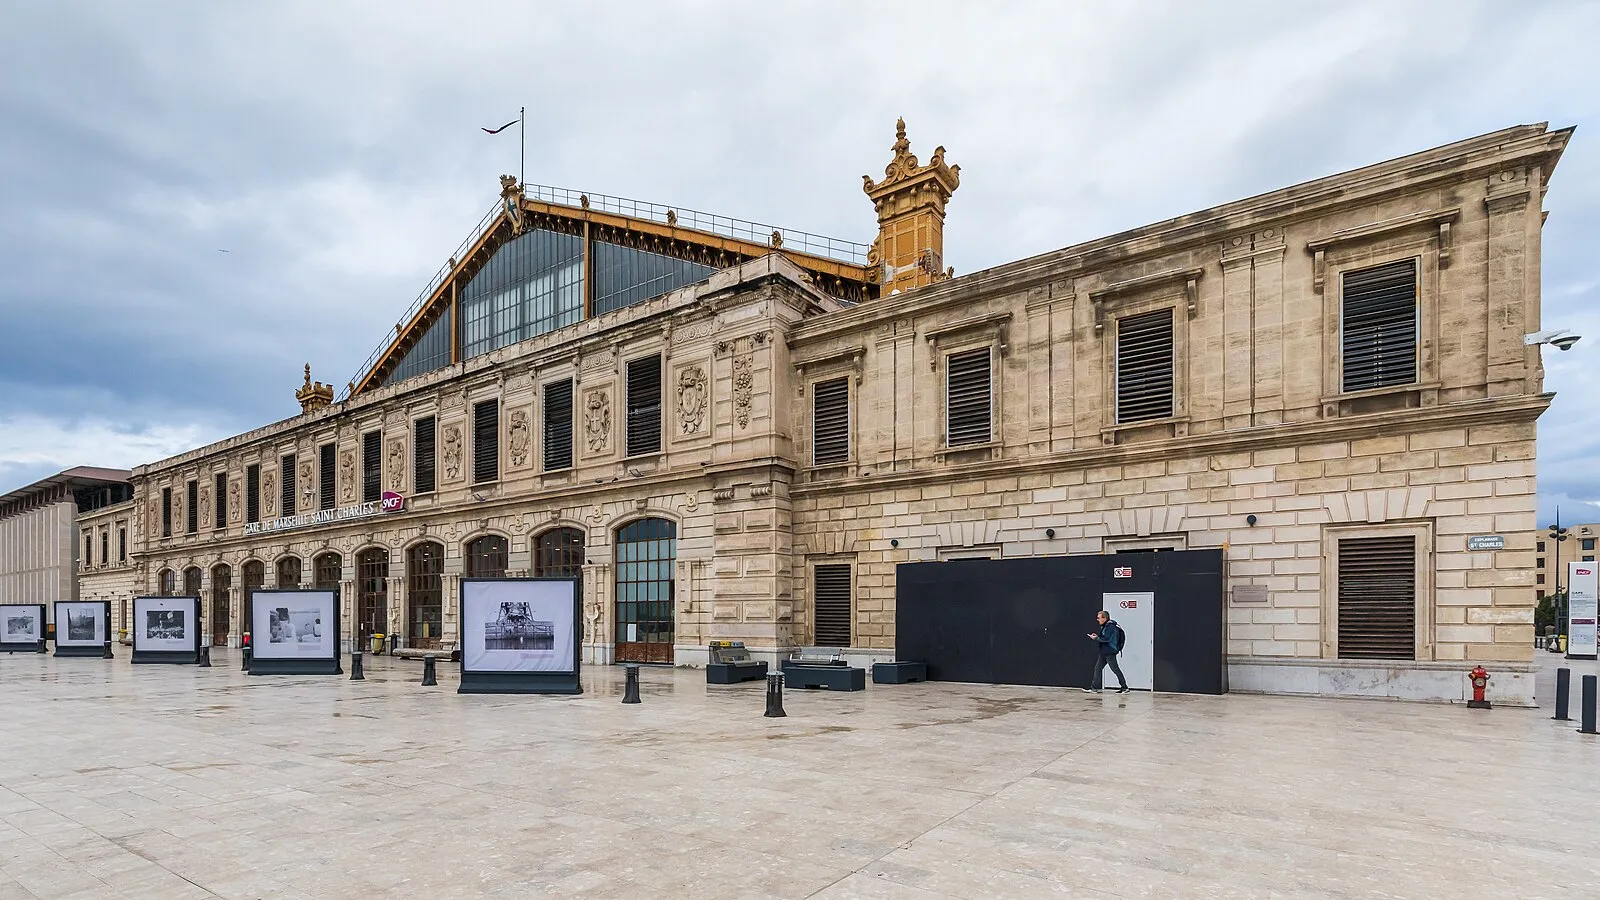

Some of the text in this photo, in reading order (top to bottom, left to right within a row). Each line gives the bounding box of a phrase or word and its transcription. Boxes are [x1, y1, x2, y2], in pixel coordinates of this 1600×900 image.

[382, 497, 401, 509] SNCF
[244, 502, 374, 534] GARE DE MARSEILLE SAINT CHARLES
